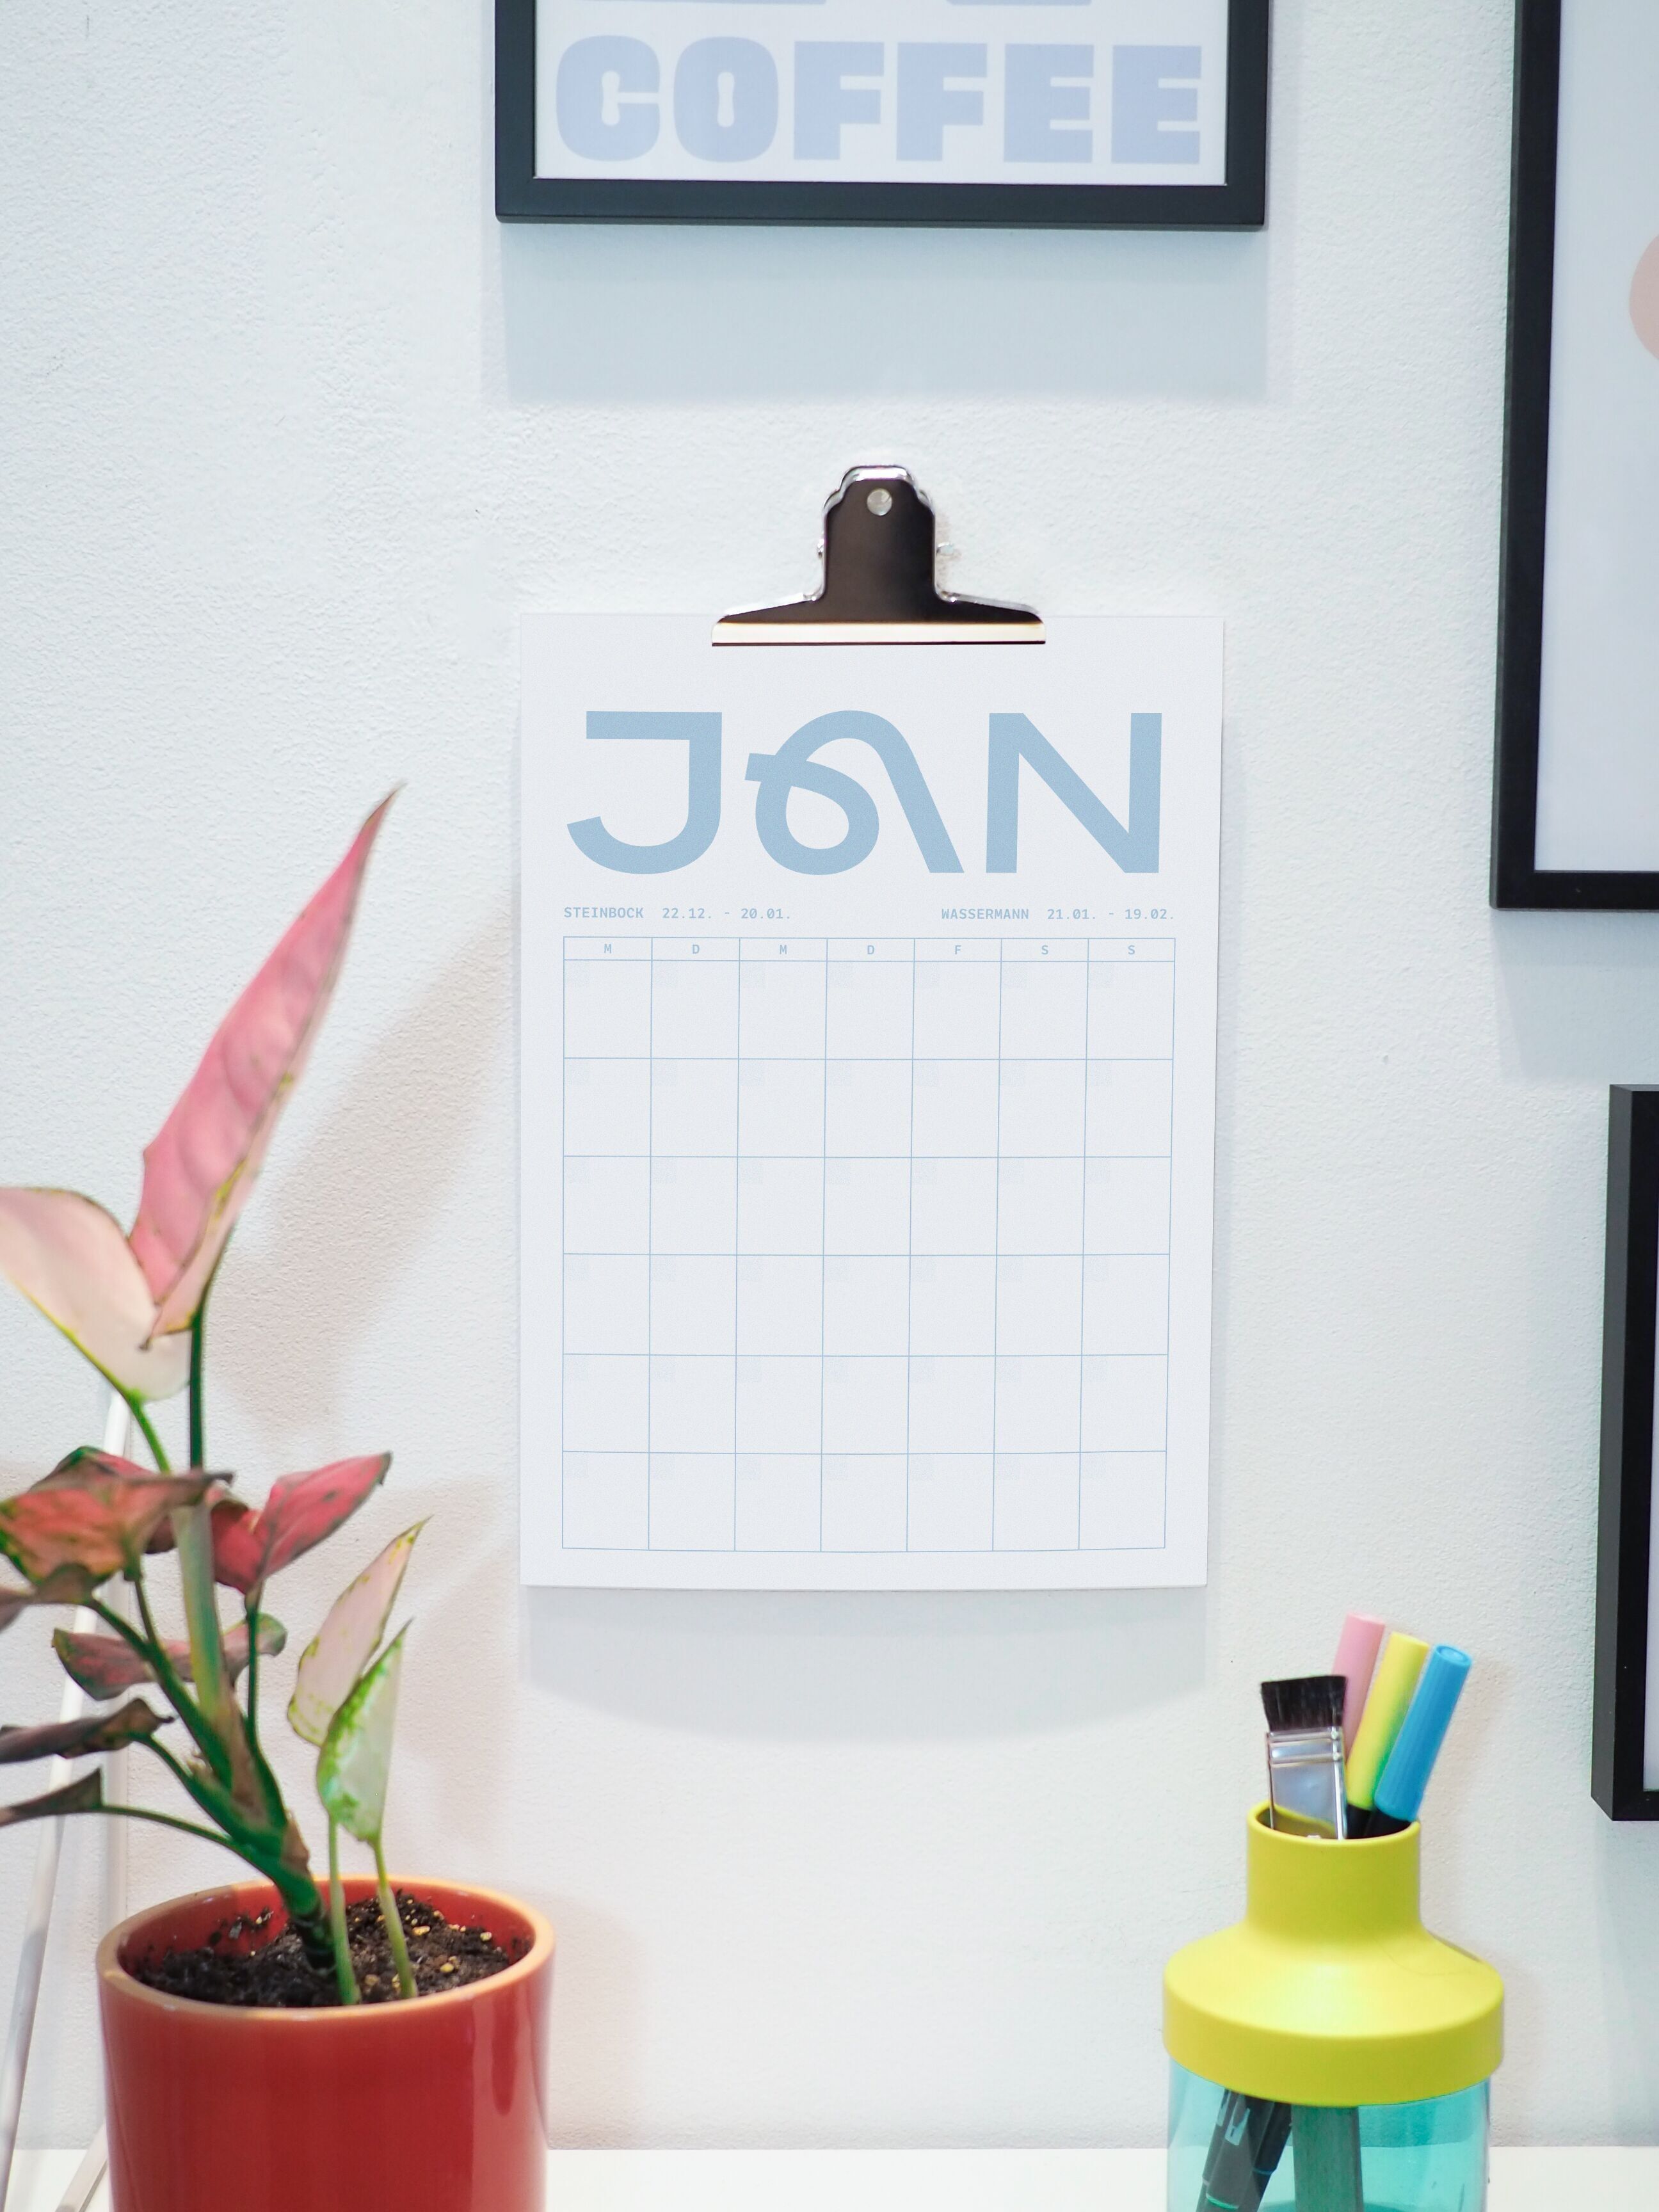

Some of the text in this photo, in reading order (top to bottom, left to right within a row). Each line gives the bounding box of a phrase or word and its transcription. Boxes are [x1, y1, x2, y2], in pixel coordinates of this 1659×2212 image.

[556, 35, 1203, 164] COFFEE
[566, 710, 1163, 876] JAN
[564, 907, 644, 918] STEINBOCK
[662, 908, 712, 919] 22.12.
[741, 908, 790, 920] 20.01.
[942, 908, 1029, 920] WASSERMANN
[1046, 909, 1096, 920] 21.01.
[1125, 909, 1174, 920] 19.02.
[604, 943, 1136, 956] M D M D F S S
